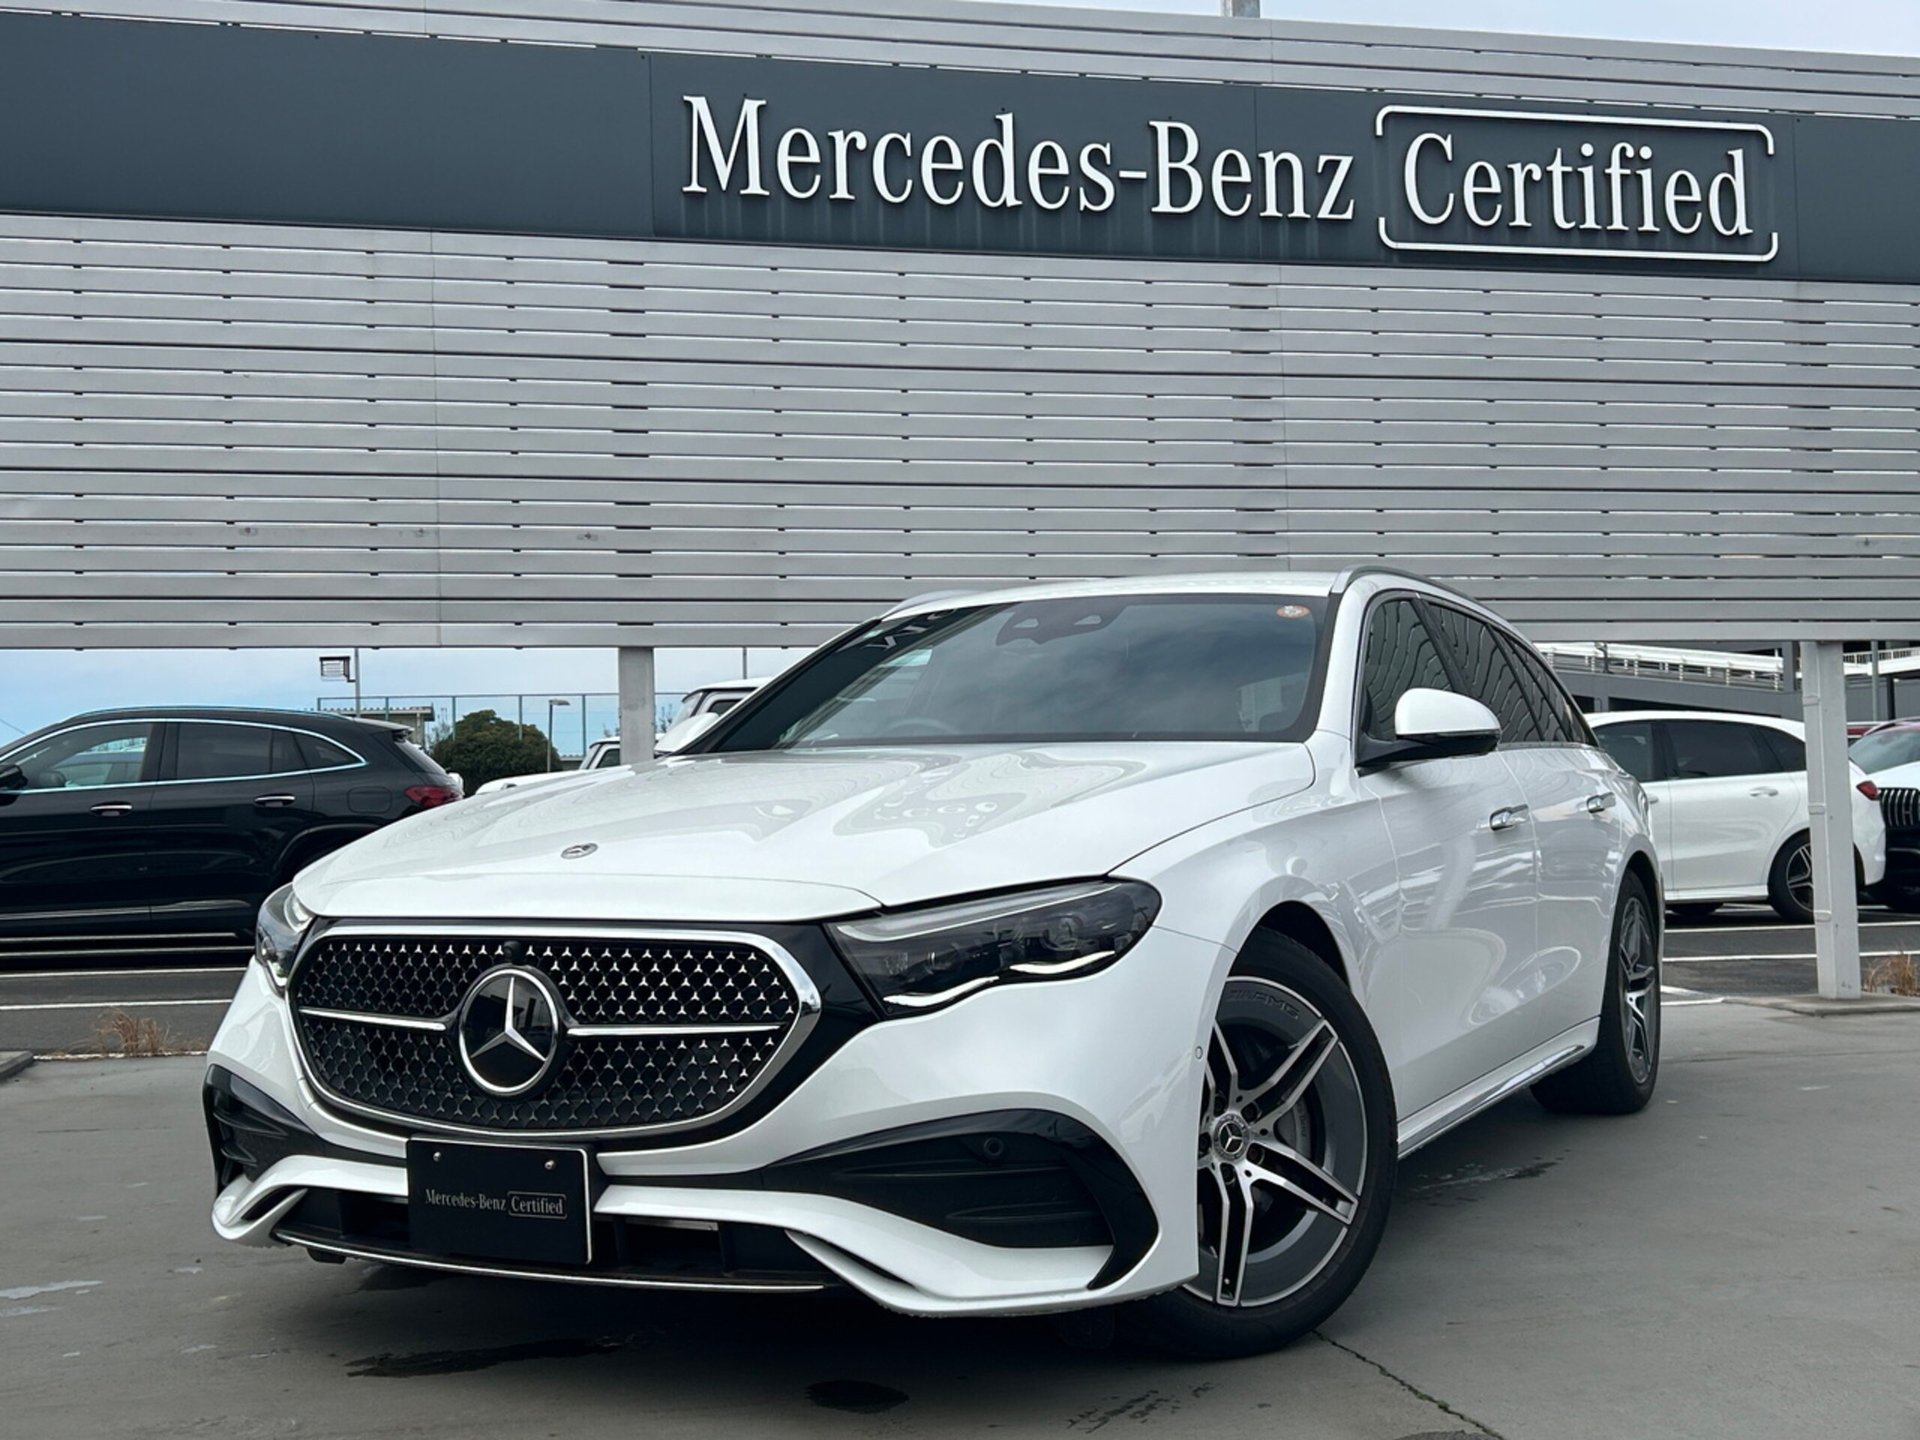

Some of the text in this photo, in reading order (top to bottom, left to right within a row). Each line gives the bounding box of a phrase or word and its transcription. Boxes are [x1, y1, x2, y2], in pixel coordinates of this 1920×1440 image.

[683, 96, 1755, 238] Mercedes-Benz Certified
[425, 1188, 564, 1215] Mercedes-Benz Certified
